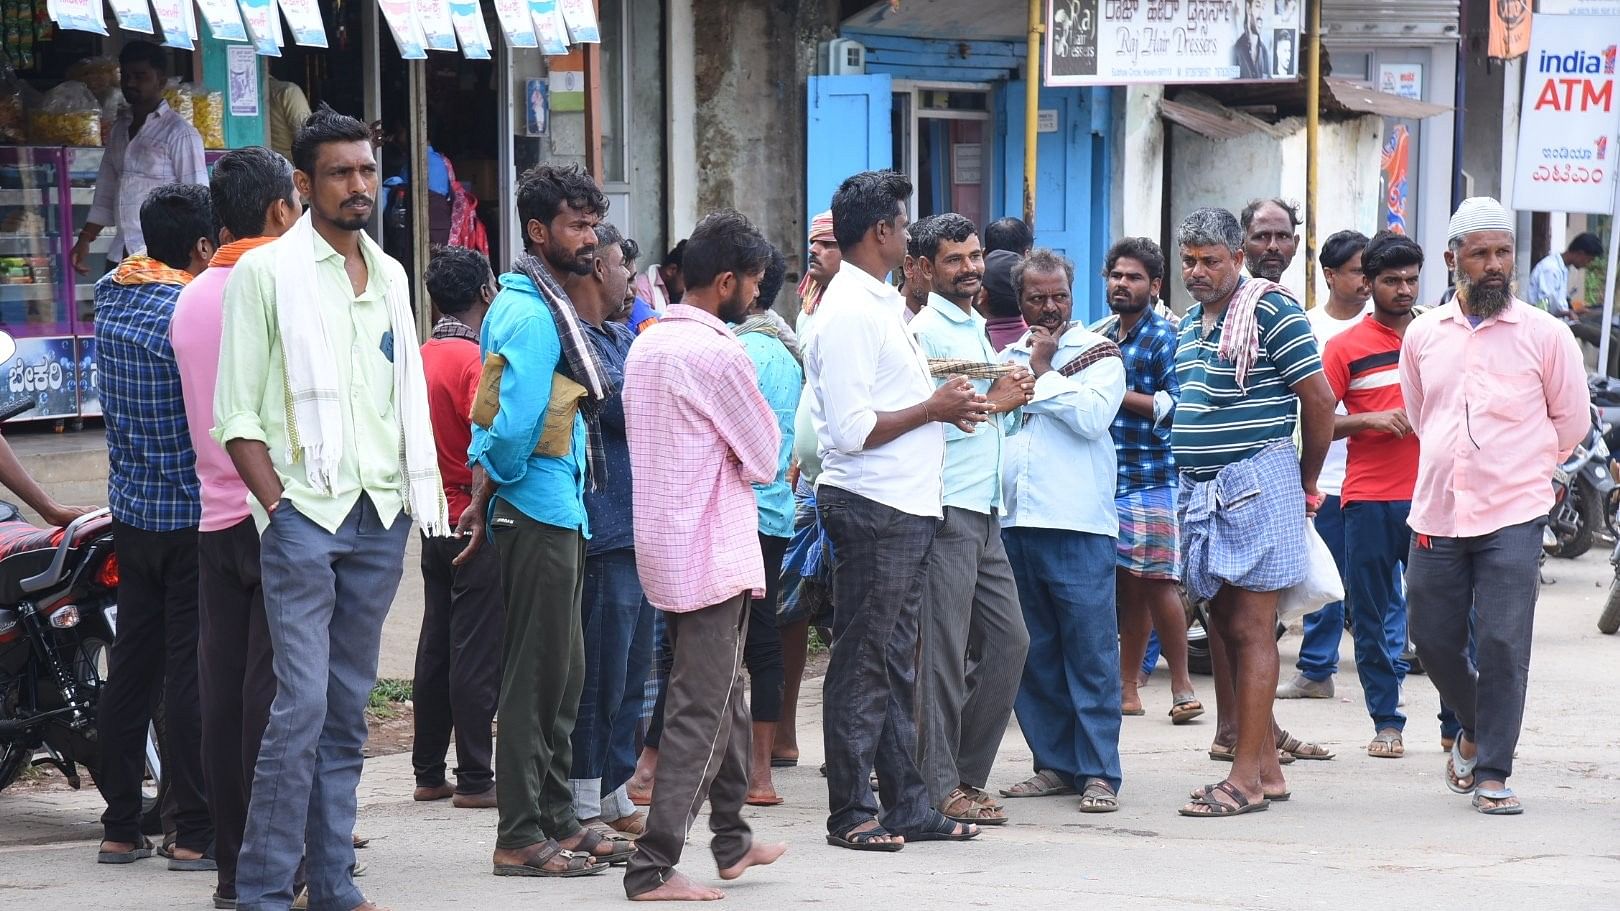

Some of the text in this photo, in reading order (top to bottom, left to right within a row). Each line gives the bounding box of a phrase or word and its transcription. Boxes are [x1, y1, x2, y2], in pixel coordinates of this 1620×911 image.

[1116, 26, 1218, 64] Raj Hair Dressers
[1534, 78, 1613, 112] ATM
[1532, 163, 1604, 184] ಎಟಿಎಂ
[9, 357, 63, 393] ಬೇಕರಿ
